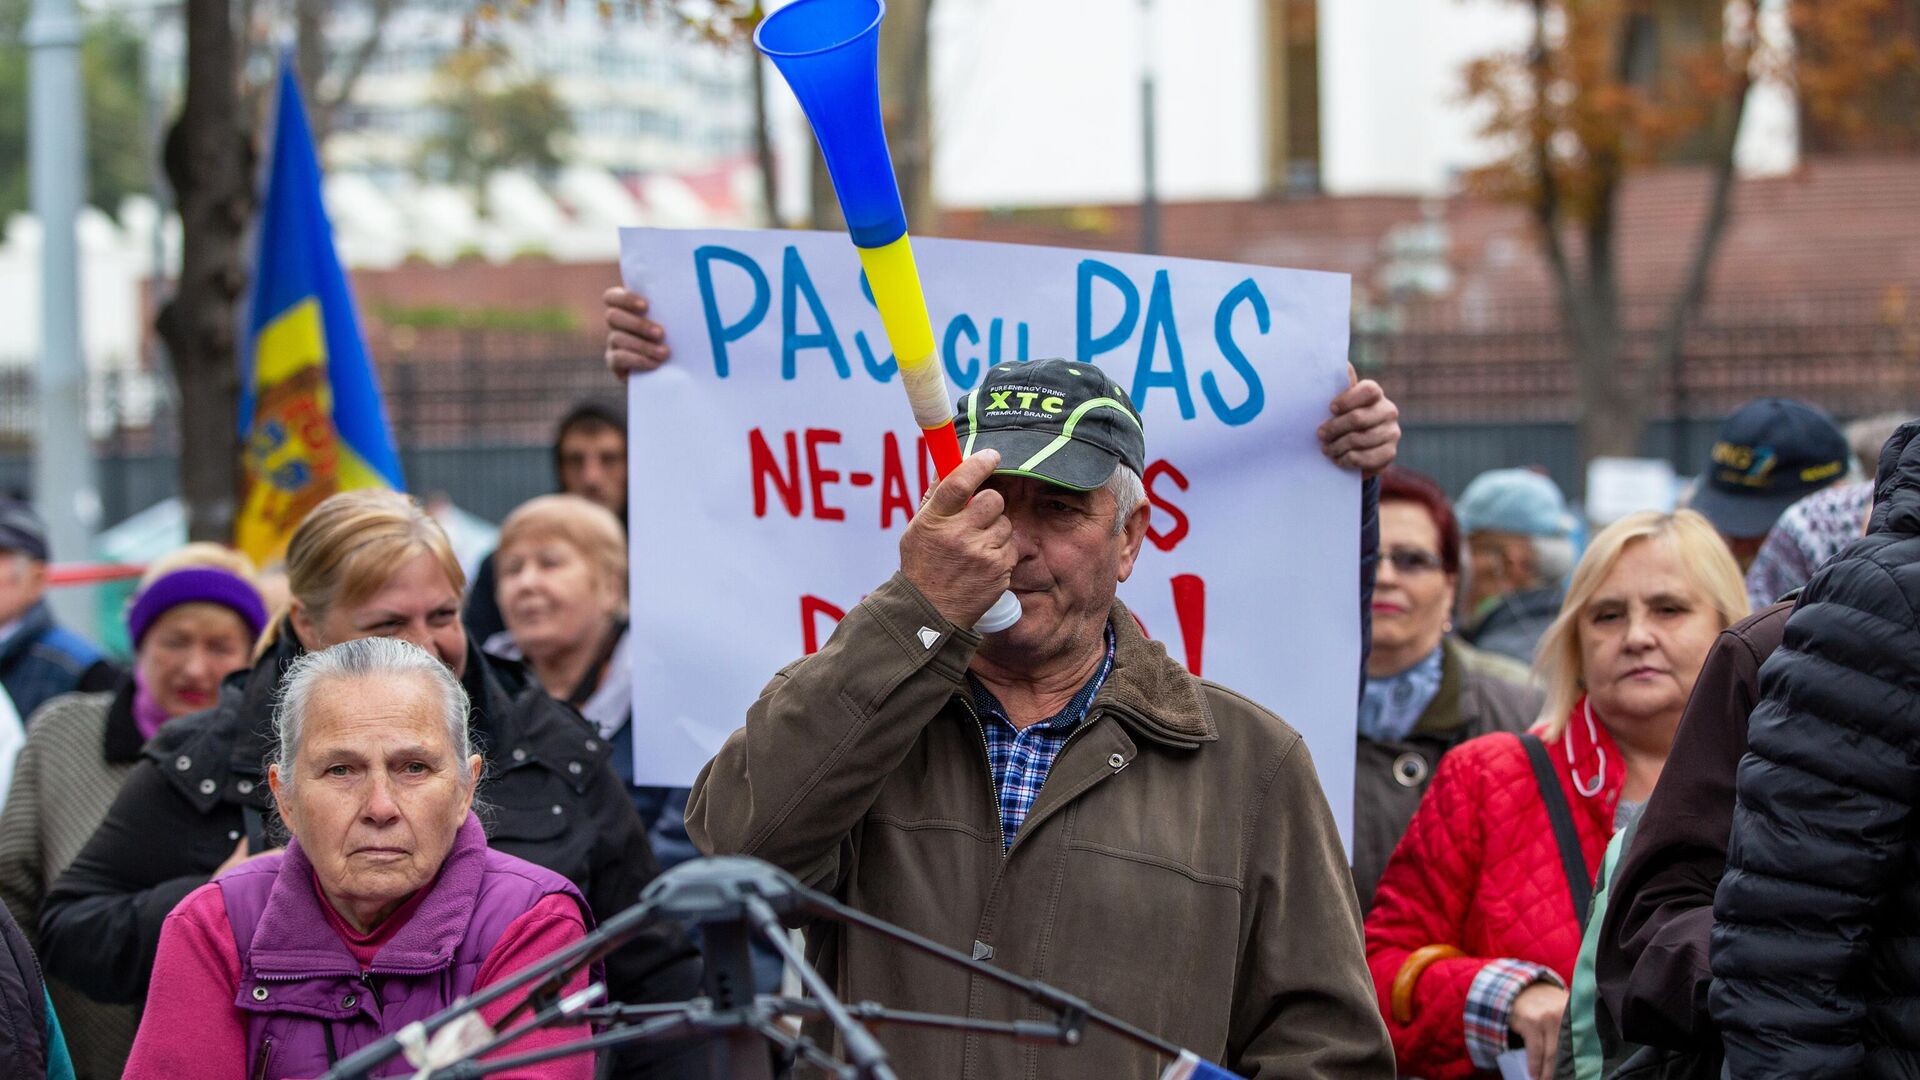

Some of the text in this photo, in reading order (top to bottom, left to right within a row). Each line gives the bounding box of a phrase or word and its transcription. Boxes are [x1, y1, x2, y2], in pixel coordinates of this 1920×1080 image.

[1076, 258, 1271, 428] PAS
[1042, 388, 1066, 397] DRINK
[985, 391, 1063, 414] XTC
[1024, 411, 1053, 419] BRAND
